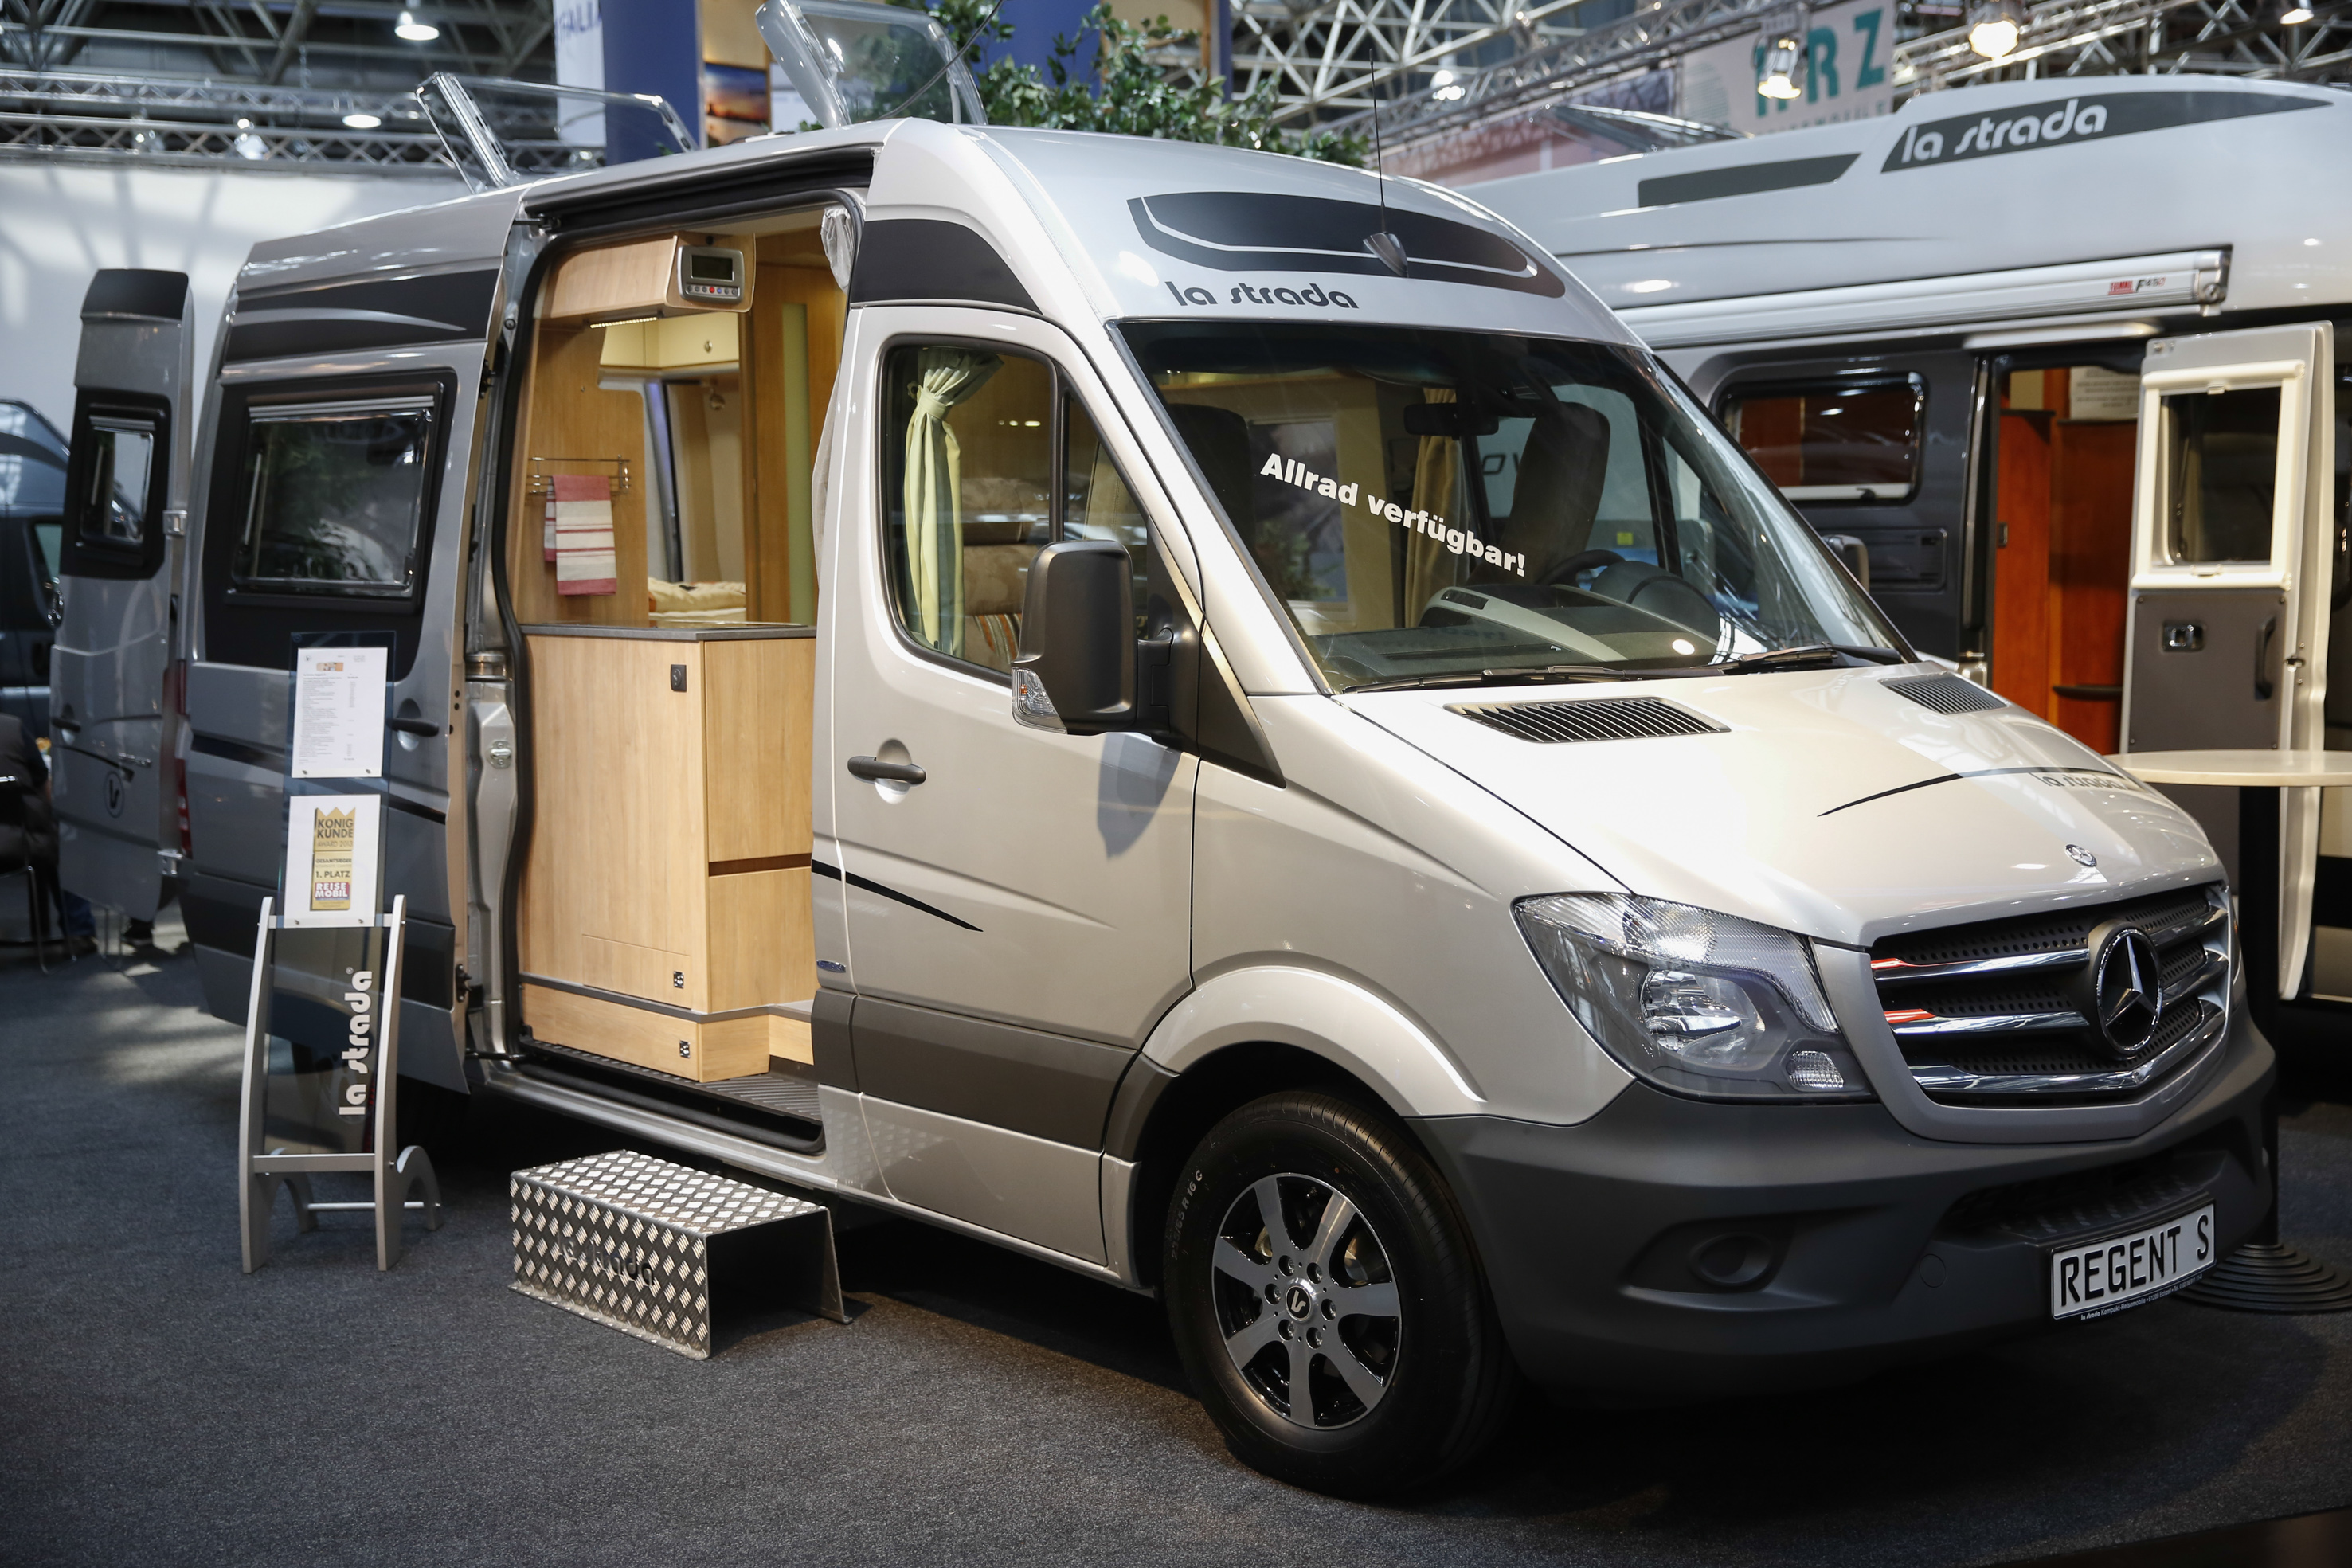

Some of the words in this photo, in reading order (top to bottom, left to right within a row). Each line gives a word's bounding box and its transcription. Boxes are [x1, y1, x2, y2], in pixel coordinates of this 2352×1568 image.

[1901, 126, 1944, 163] la
[1954, 98, 2108, 155] strada
[1164, 281, 1219, 307] la
[1231, 283, 1359, 309] strada
[1260, 453, 1359, 506] Allrad
[1368, 494, 1525, 577] verfügbar!
[2030, 772, 2065, 787] la
[317, 828, 353, 839] KUNDE
[315, 890, 348, 898] MOBIL
[341, 971, 373, 1074] strada
[339, 1084, 367, 1115] la
[1181, 1197, 1189, 1210] R
[1187, 1181, 1196, 1197] 16
[1195, 1169, 1203, 1182] C
[2060, 1225, 2181, 1307] REGENT
[2197, 1214, 2209, 1261] S
